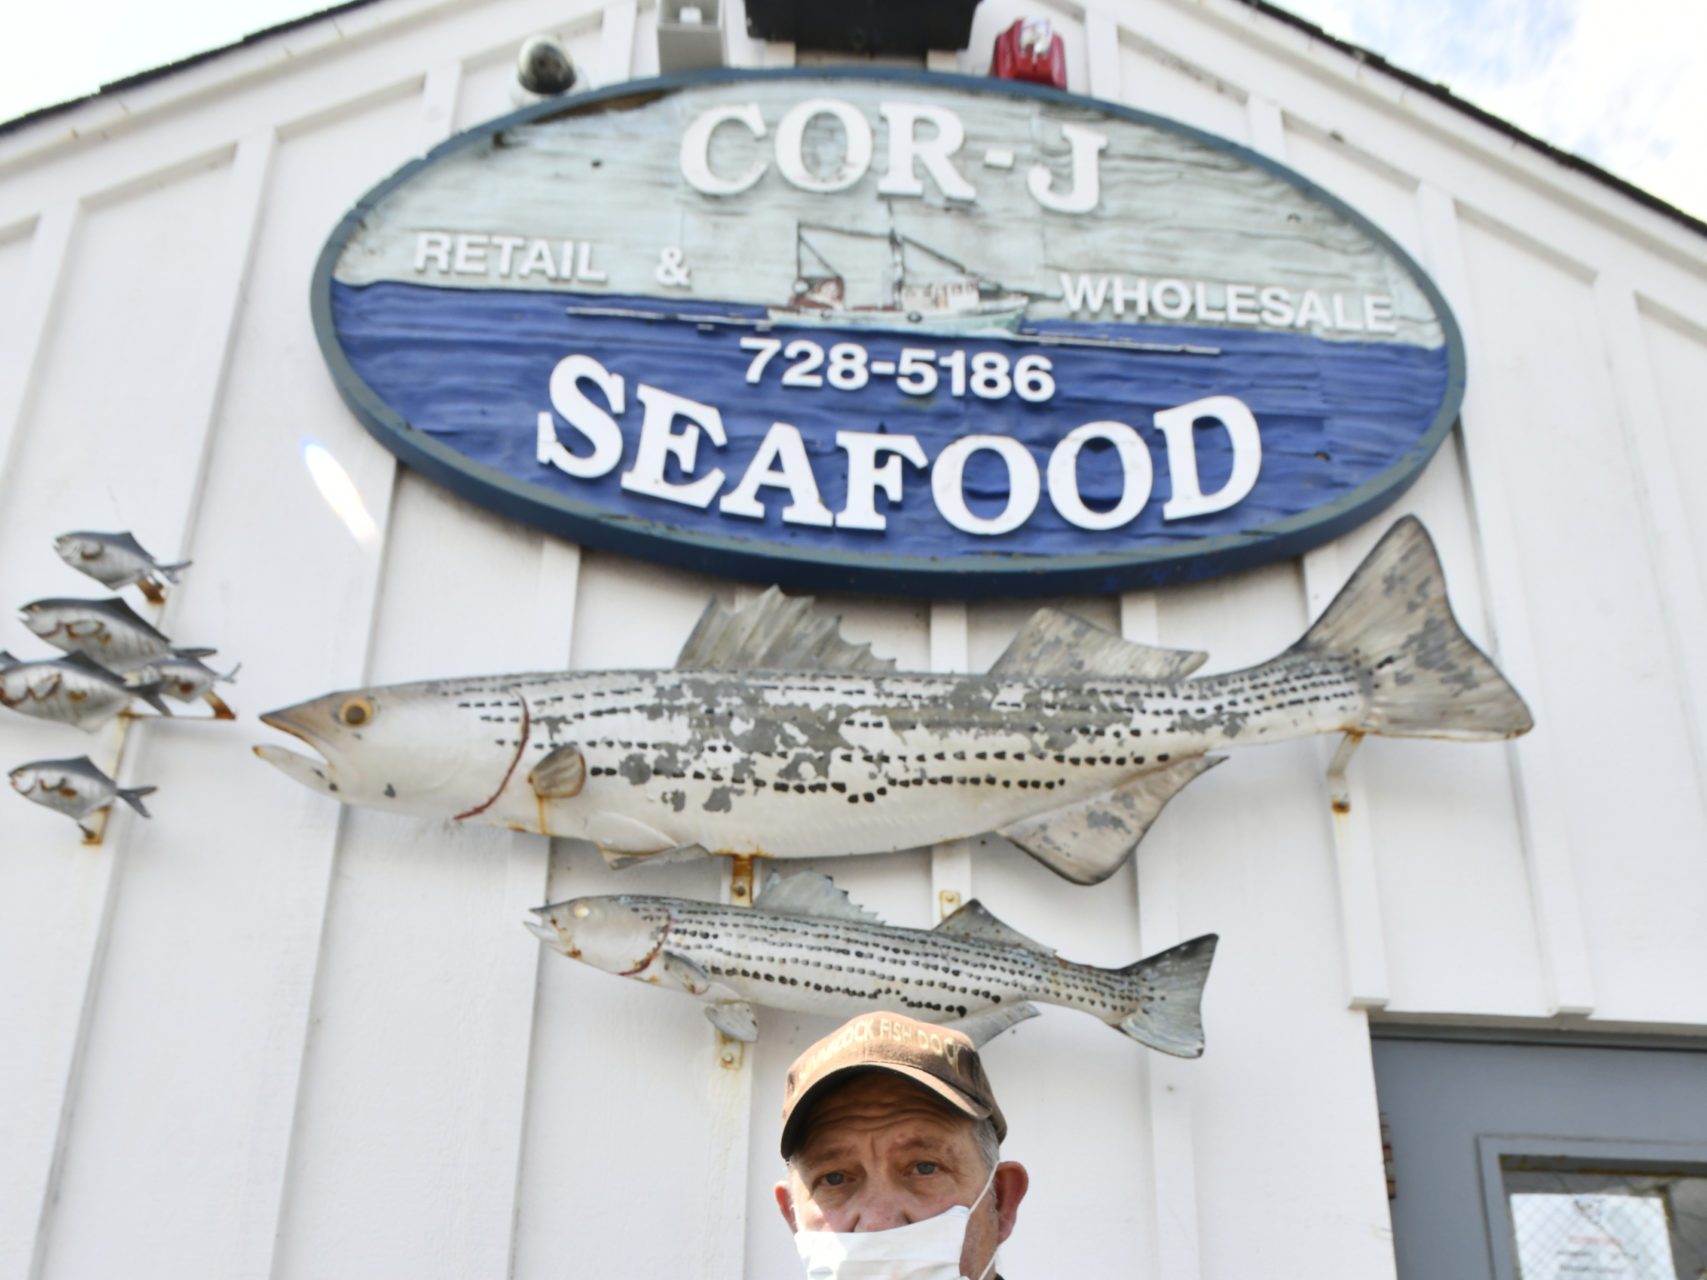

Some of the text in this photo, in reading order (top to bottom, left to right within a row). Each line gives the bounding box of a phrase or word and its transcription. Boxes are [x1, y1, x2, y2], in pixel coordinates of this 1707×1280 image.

[680, 97, 1109, 215] COR-J
[414, 231, 1398, 333] RETAIL & WHOLESALE
[740, 336, 1056, 401] 728-5186
[536, 353, 1263, 535] SEAFOOD
[879, 1017, 912, 1042] FISH
